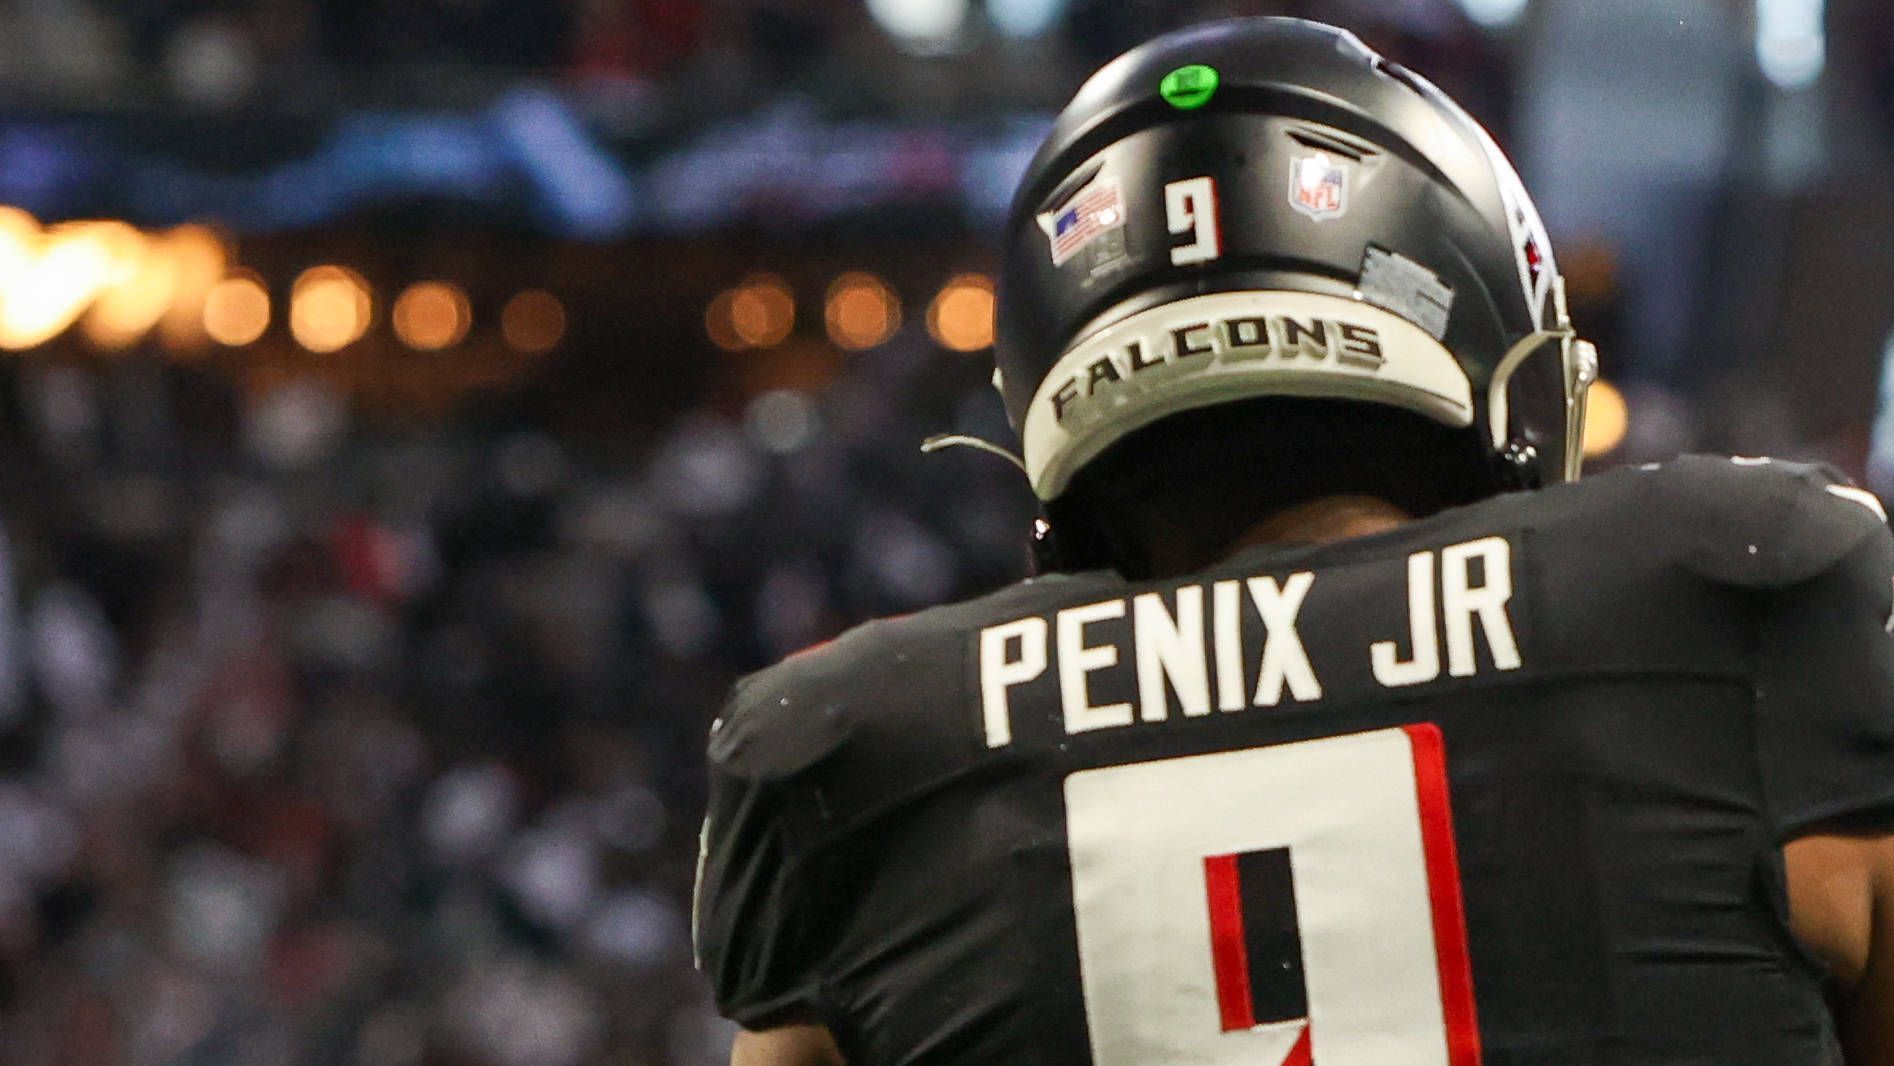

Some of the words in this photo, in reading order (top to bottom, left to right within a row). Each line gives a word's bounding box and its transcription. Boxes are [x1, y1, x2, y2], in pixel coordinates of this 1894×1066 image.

[1164, 176, 1223, 267] 9
[1051, 316, 1383, 423] FALCONS
[979, 571, 1323, 749] PENIX
[1370, 535, 1523, 688] JR
